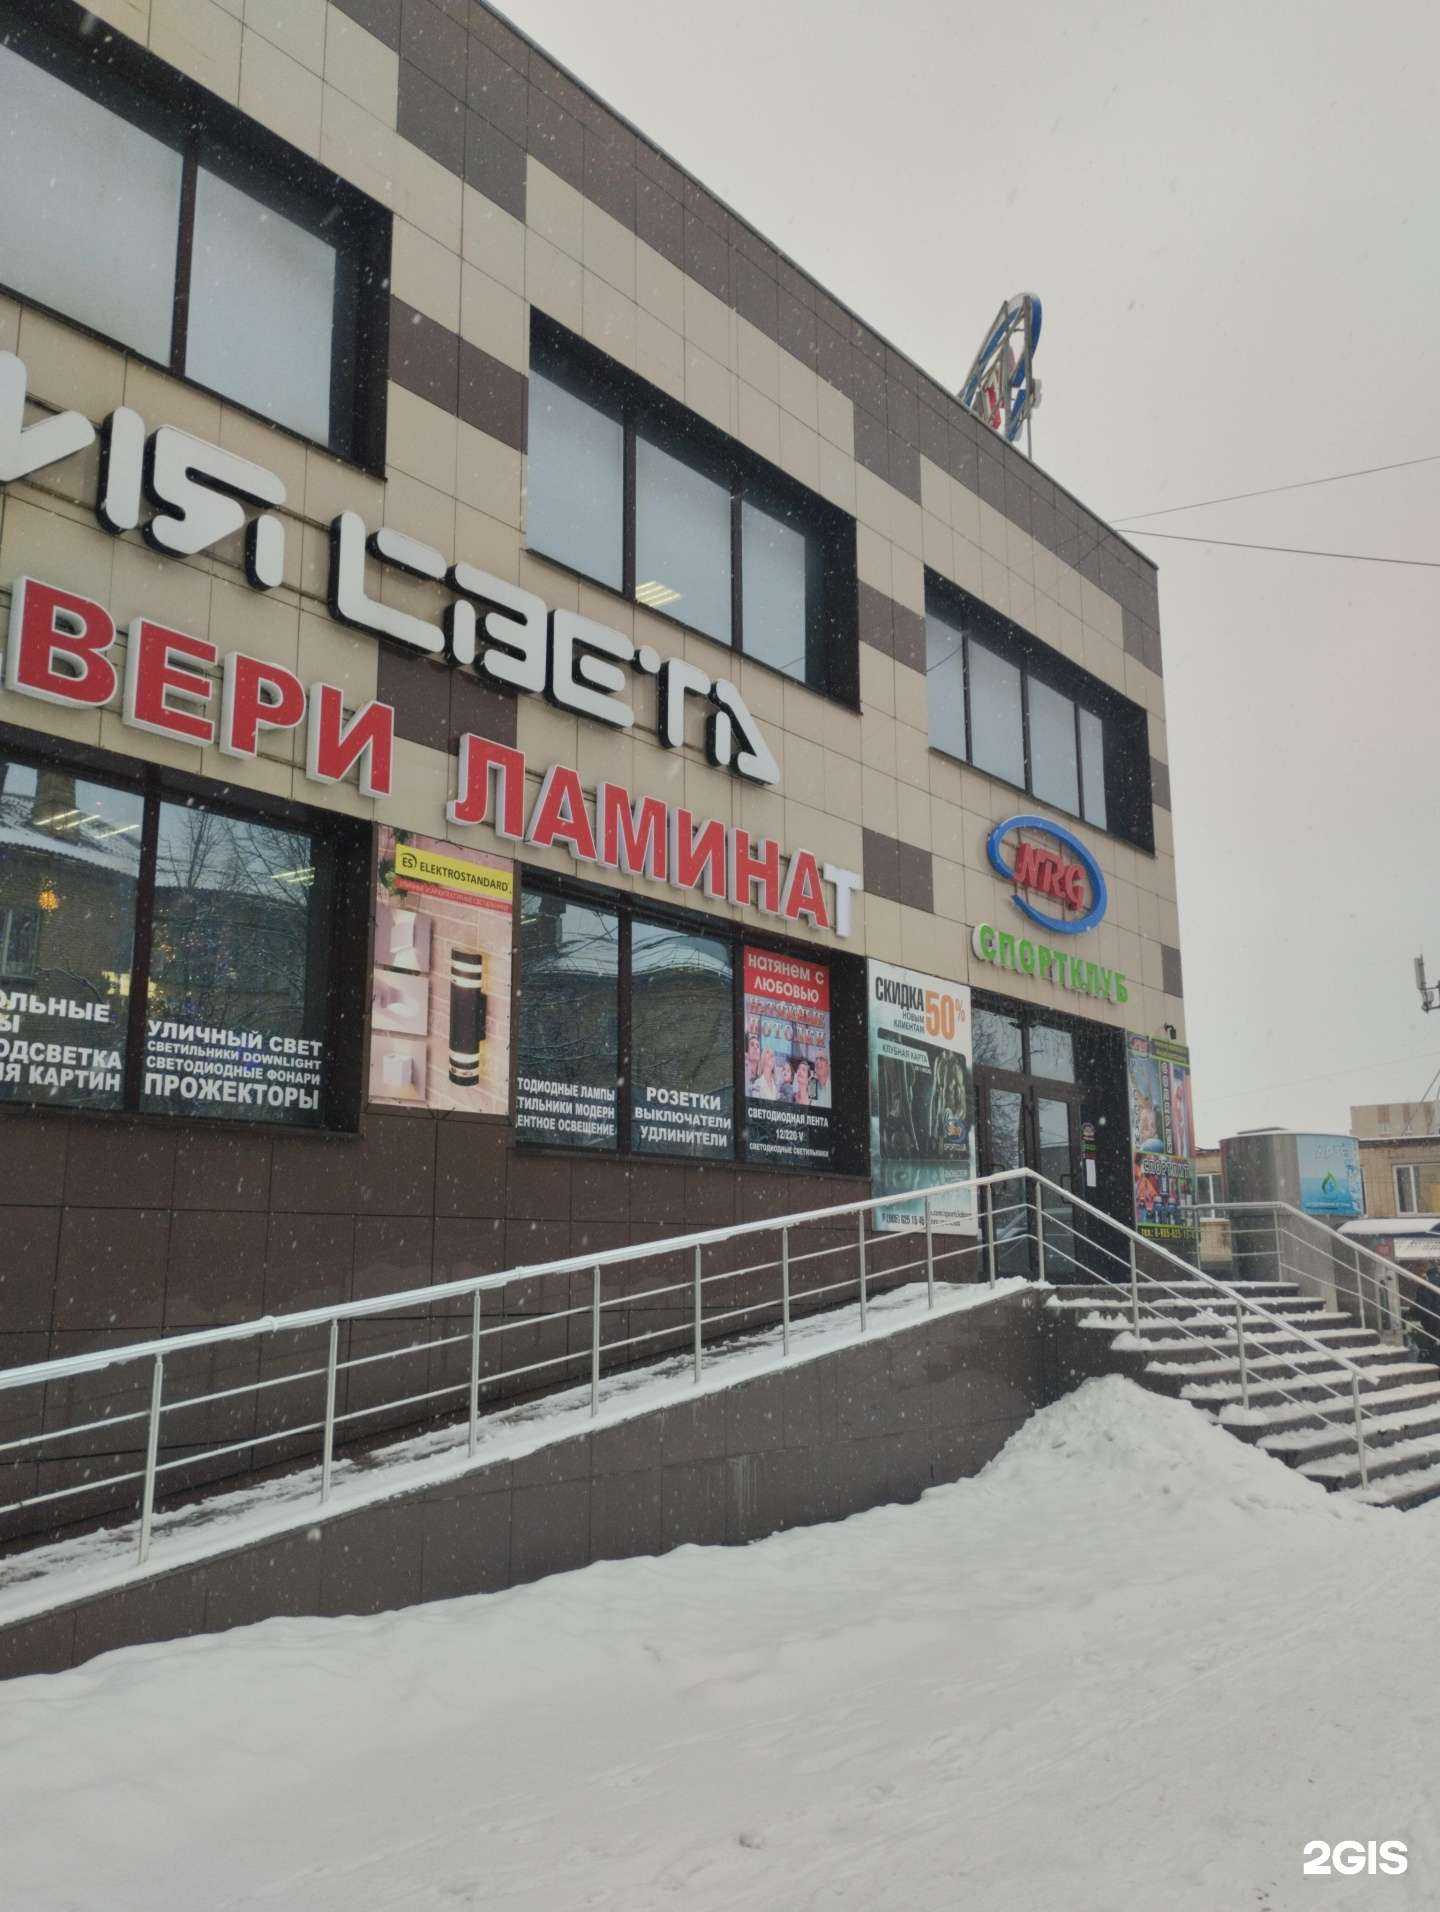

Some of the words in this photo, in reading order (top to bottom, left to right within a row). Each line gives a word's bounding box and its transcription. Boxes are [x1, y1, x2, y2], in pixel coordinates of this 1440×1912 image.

[0, 574, 396, 800] ВЕРИ
[446, 732, 864, 938] ЛАМИНАТ
[419, 862, 510, 892] ELEKTROSTANDARD
[971, 923, 1129, 1005] СПОРТКЛУБ
[875, 976, 925, 1012] СКИДКА
[147, 1019, 263, 1050] УЛИЧНЫЙ
[269, 1036, 323, 1057] СВЕТ
[147, 1040, 239, 1061] СВЕТИЛЬНИКИ
[242, 1051, 322, 1070] DOWNLIGHT
[28, 1064, 121, 1092] КАРТИН
[146, 1055, 263, 1080] СВЕТОДИОДНЫЕ
[267, 1069, 321, 1085] ФОНАРИ
[144, 1072, 319, 1110] ПРОЖЕКТОРЫ
[580, 1085, 615, 1102] ЛАМПЫ
[646, 1086, 721, 1111] РОЗЕТКИ
[515, 1095, 573, 1114] ТИЛЬНИКИ
[575, 1103, 615, 1120] МОДЕРН
[634, 1106, 732, 1130] ВЫКЛЮЧАТЕЛИ
[747, 1107, 806, 1125] СВЕТОДИОДНАЯ
[806, 1115, 829, 1128] ЛЕНТА
[515, 1114, 556, 1130] ЕНТНОЕ
[558, 1119, 615, 1136] ОСВЕЩЕНИЕ
[640, 1125, 728, 1148] УДЛИНИТЕЛИ
